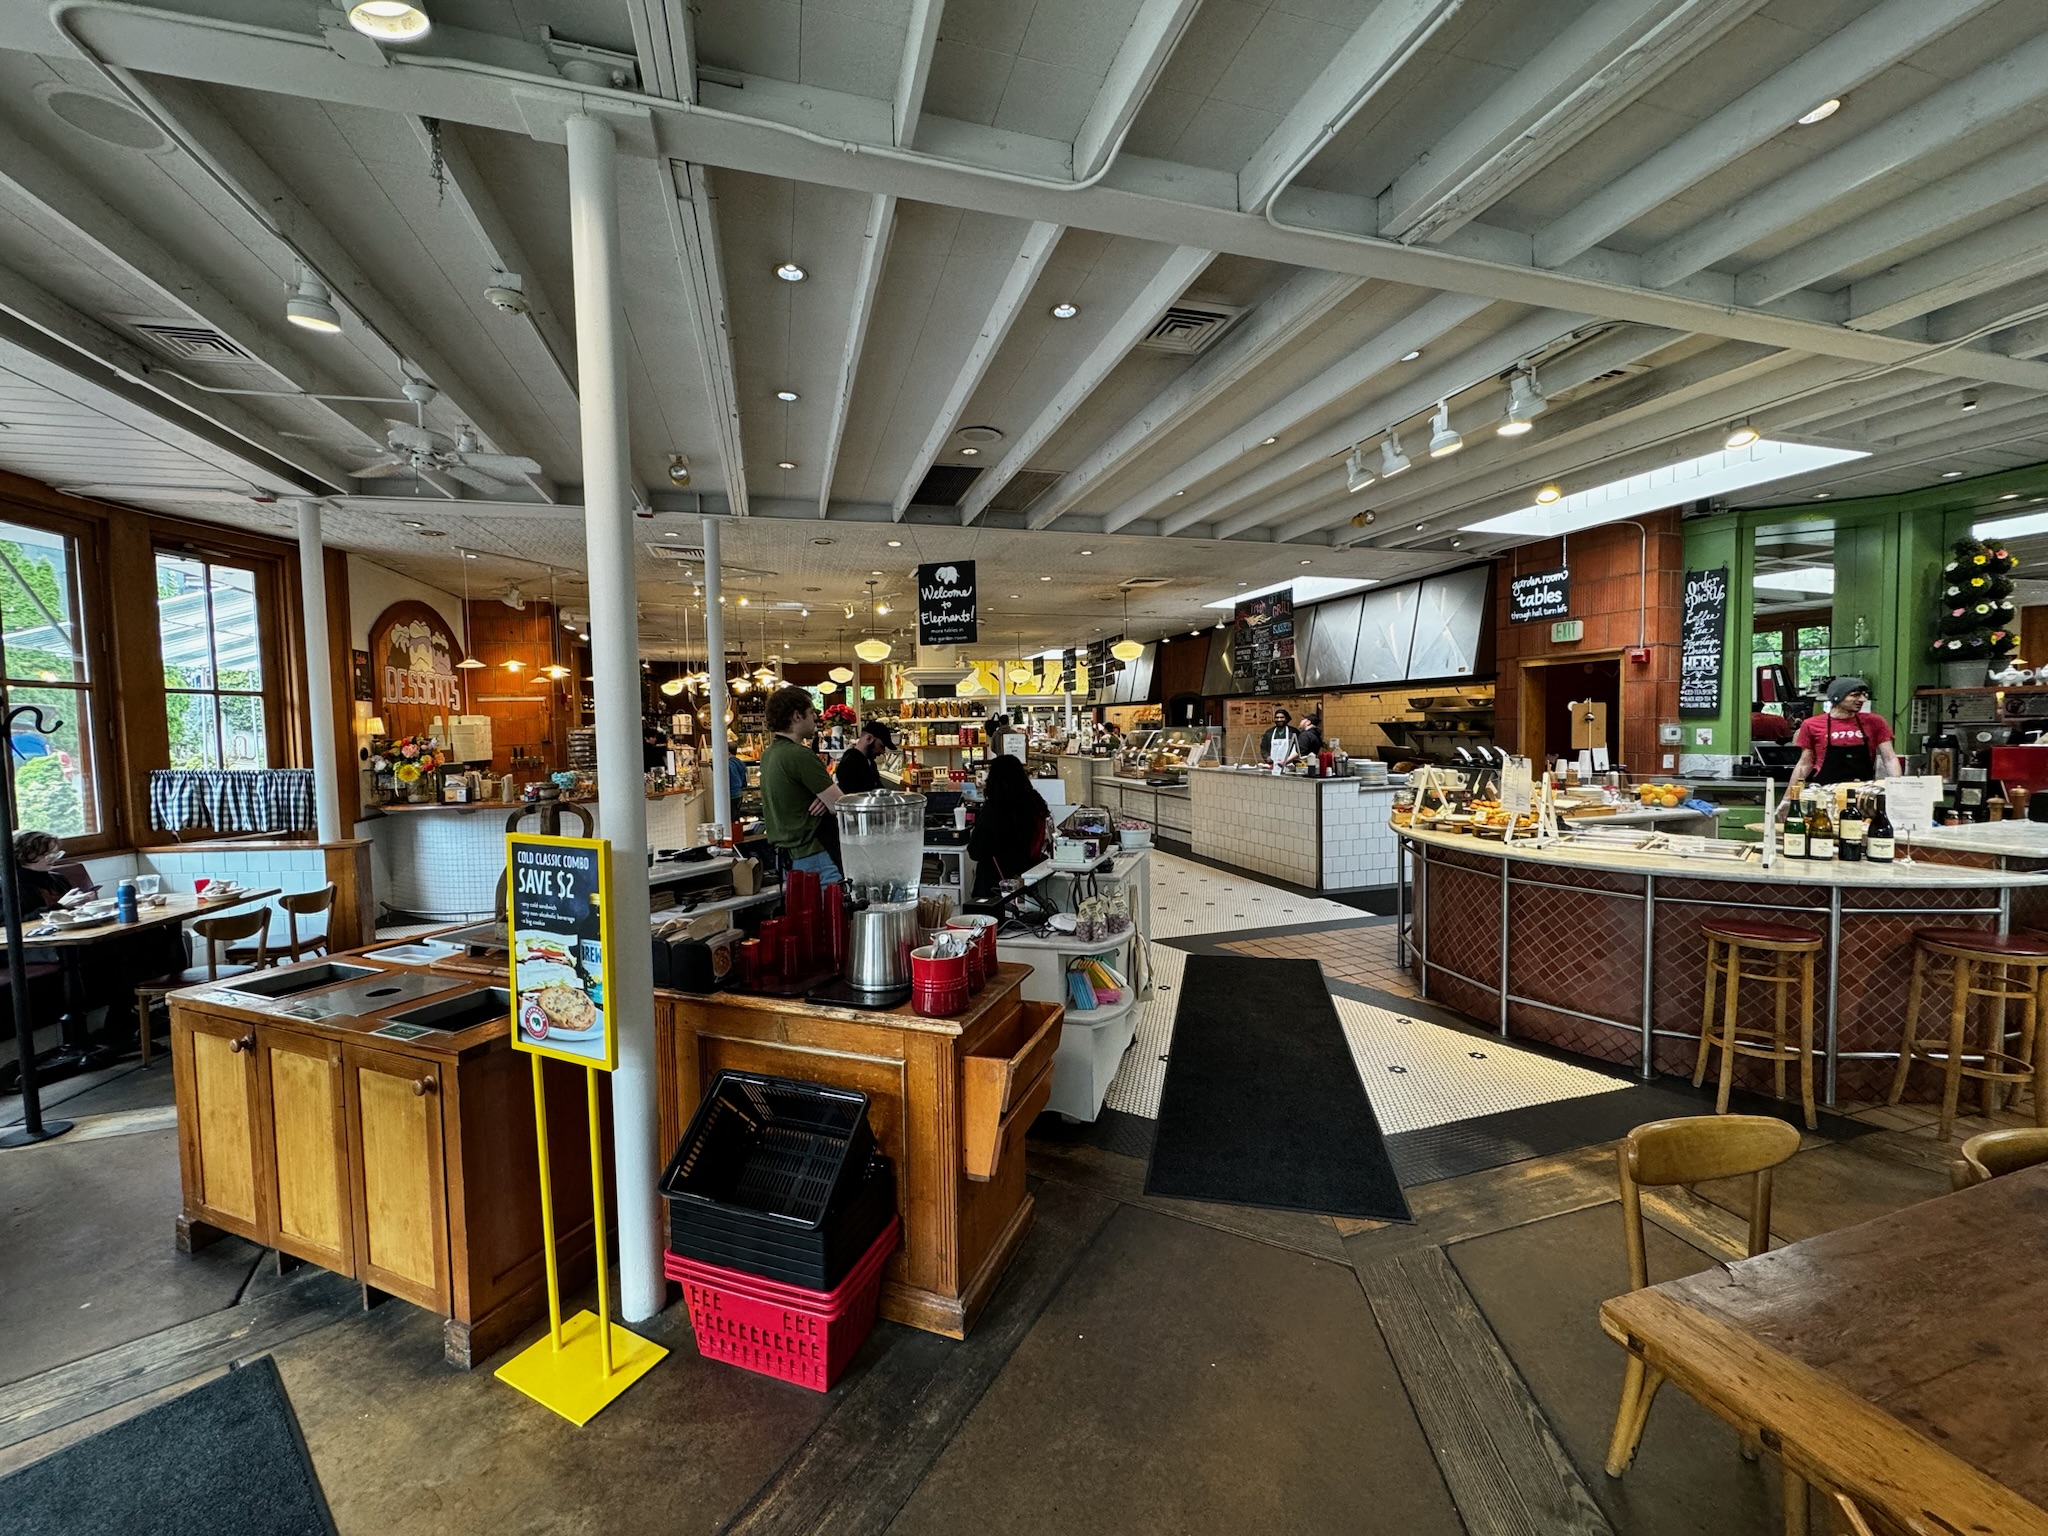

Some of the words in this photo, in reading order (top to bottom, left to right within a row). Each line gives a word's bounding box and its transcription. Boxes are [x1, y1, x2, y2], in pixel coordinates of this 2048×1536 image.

[1511, 576, 1542, 597] garden
[1542, 569, 1569, 584] room
[1687, 570, 1720, 595] Order
[921, 585, 973, 601] Welcome
[1516, 585, 1563, 608] tables
[941, 601, 952, 610] to
[1272, 601, 1292, 618] GRILL
[1511, 610, 1531, 622] through
[1543, 608, 1557, 616] turn
[1557, 604, 1568, 613] left
[920, 605, 975, 626] Elephants!
[1683, 610, 1720, 626] Coffee
[1556, 622, 1576, 640] EXIT
[1691, 624, 1714, 637] Tea
[1682, 655, 1720, 669] HERE
[384, 666, 461, 711] DESSERTS
[517, 851, 534, 865] COLD
[535, 853, 561, 868] CLASSIC
[563, 855, 589, 870] COMBO
[518, 867, 553, 896] SAVE
[557, 870, 575, 900] $2
